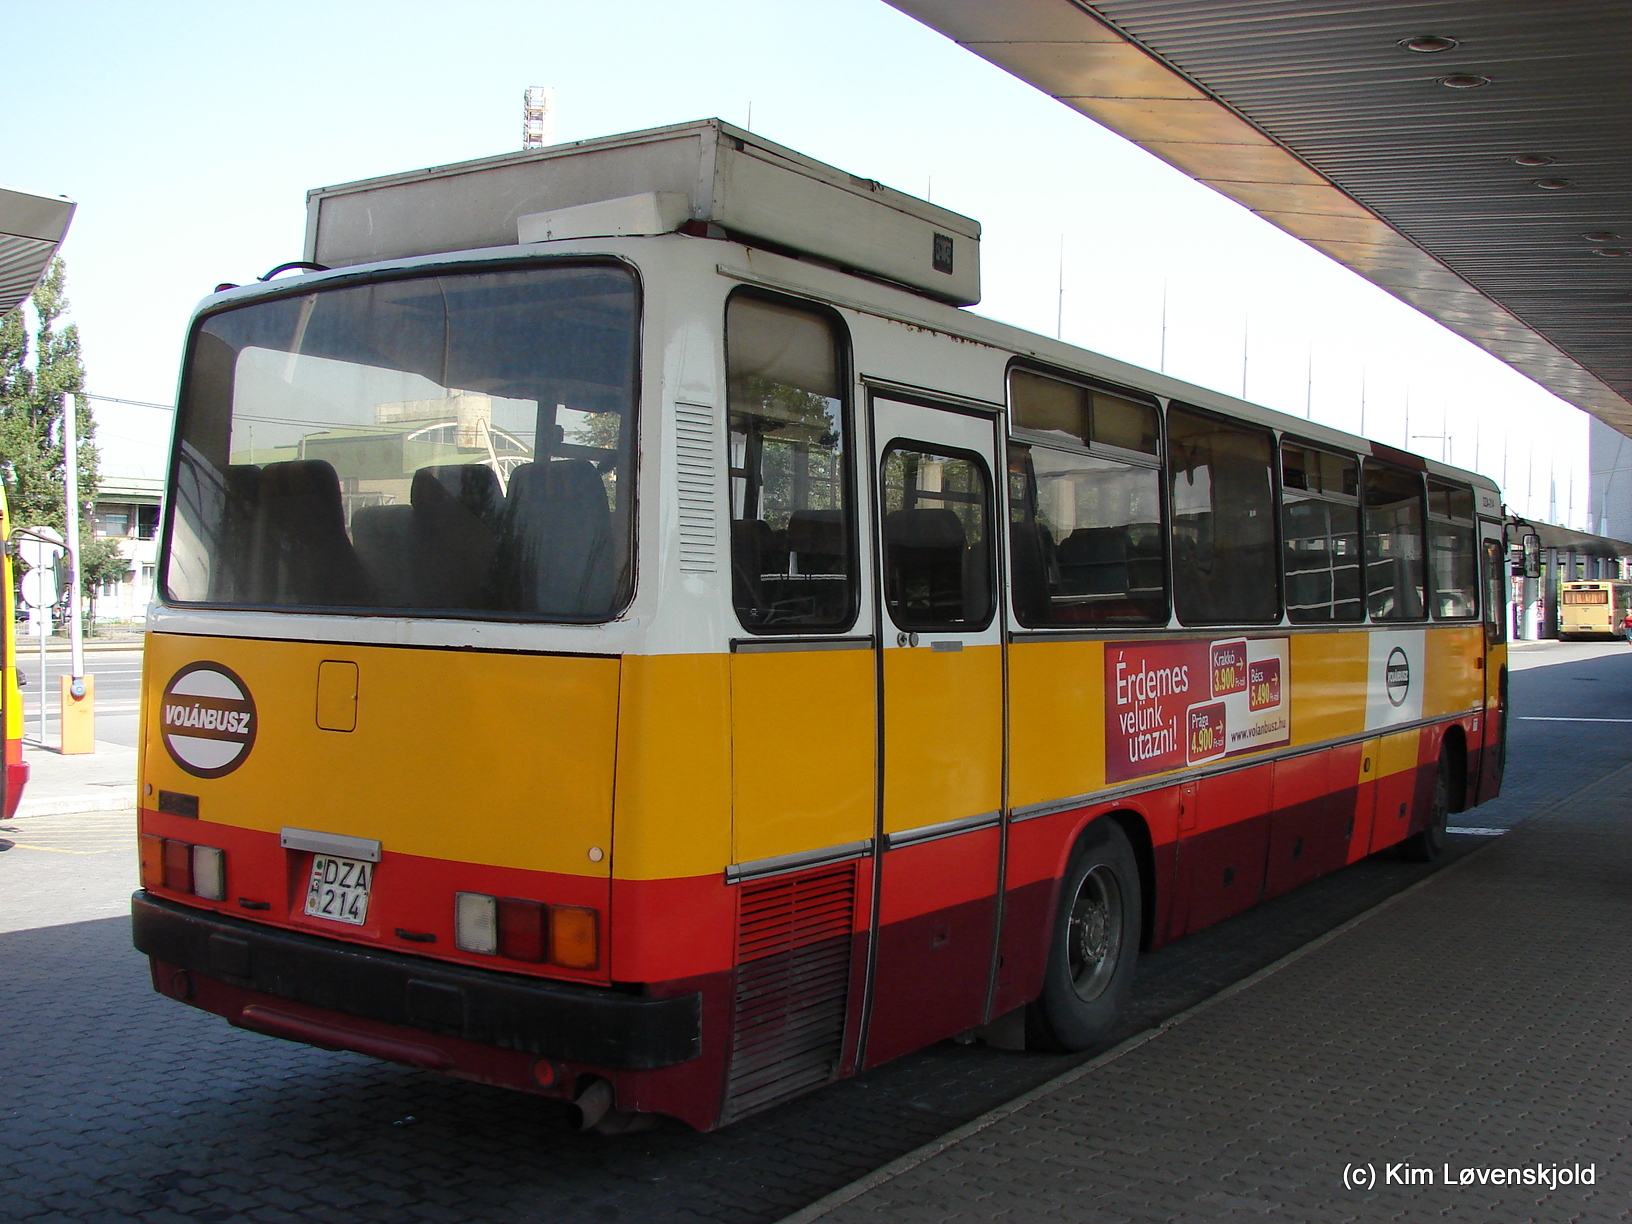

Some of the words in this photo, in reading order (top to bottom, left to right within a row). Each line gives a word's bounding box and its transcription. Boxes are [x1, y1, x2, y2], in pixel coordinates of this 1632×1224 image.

[1213, 650, 1235, 667] Krakkó
[1116, 650, 1189, 705] Érdemes
[1214, 667, 1235, 691] 3.900
[1251, 668, 1264, 683] Bécs
[1251, 682, 1270, 706] 5.490
[165, 703, 250, 734] VOLÁNBUSZ
[1119, 696, 1163, 735] velünk
[1191, 713, 1209, 730] Prága
[1128, 715, 1177, 762] utazni!
[1191, 727, 1213, 754] 4.900
[1231, 717, 1286, 742] www.volanbusz.hu
[324, 859, 367, 890] DZA
[322, 889, 359, 919] 214
